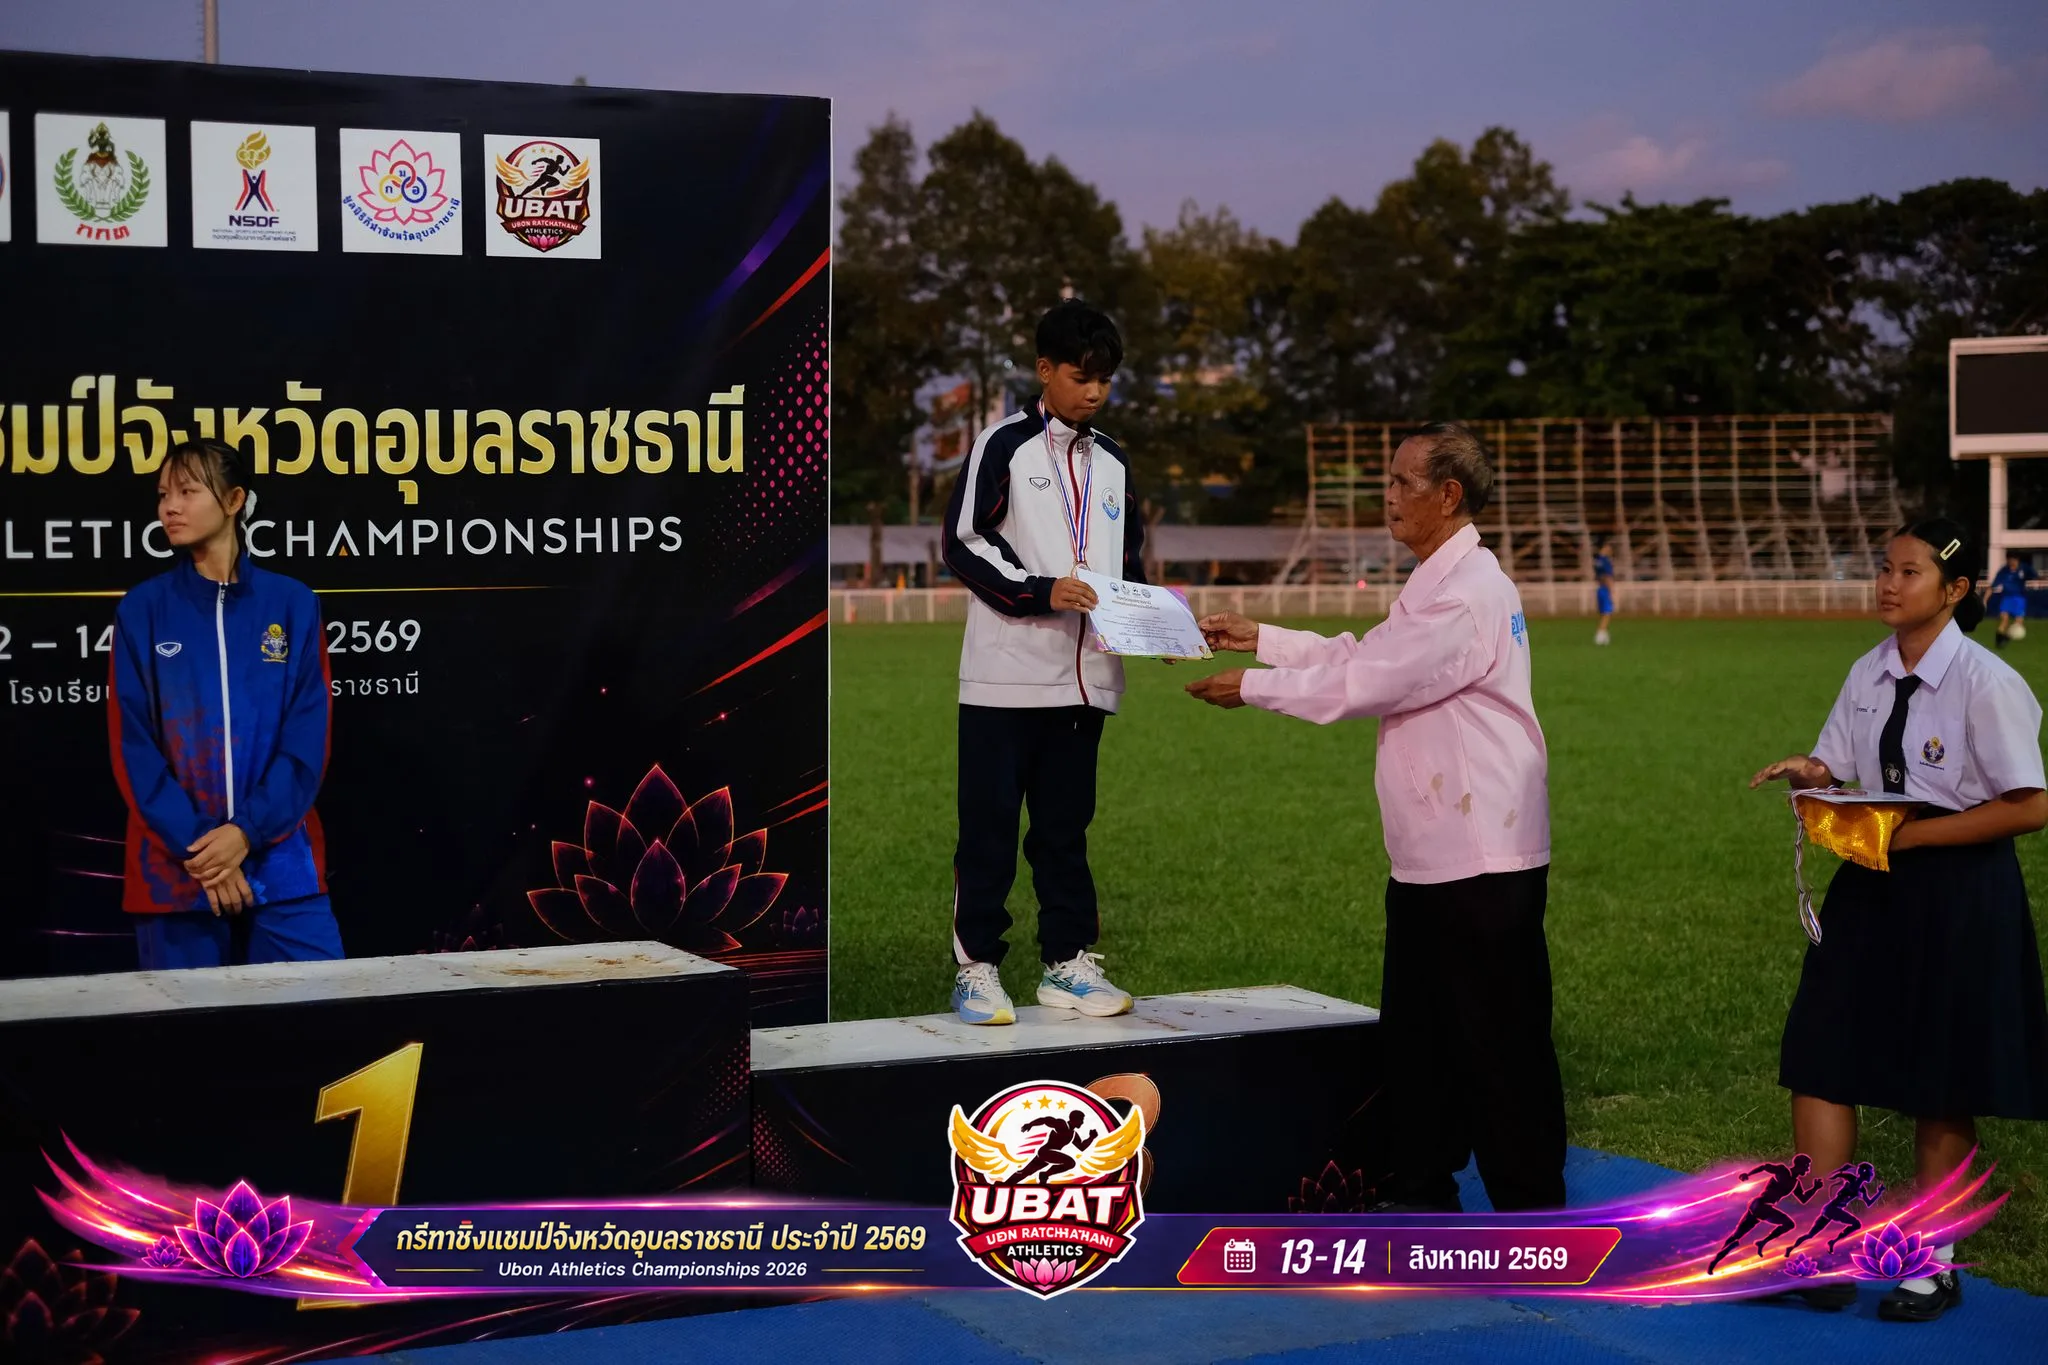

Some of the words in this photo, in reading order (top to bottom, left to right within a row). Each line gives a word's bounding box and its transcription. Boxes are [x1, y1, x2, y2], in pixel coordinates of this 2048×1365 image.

[504, 197, 582, 220] UBAT
[76, 223, 130, 241] กกท
[229, 215, 279, 228] NSDF
[511, 221, 531, 229] UBON
[532, 220, 578, 230] RATCHATHANI
[0, 375, 745, 504] มป์จัหวัดอุบลราชธานี
[6, 520, 174, 559] LETIC
[245, 516, 682, 558] CHAMPIONSHIPS
[76, 625, 115, 658] 14
[327, 619, 421, 653] 2569
[9, 679, 110, 704] โรงเรีย
